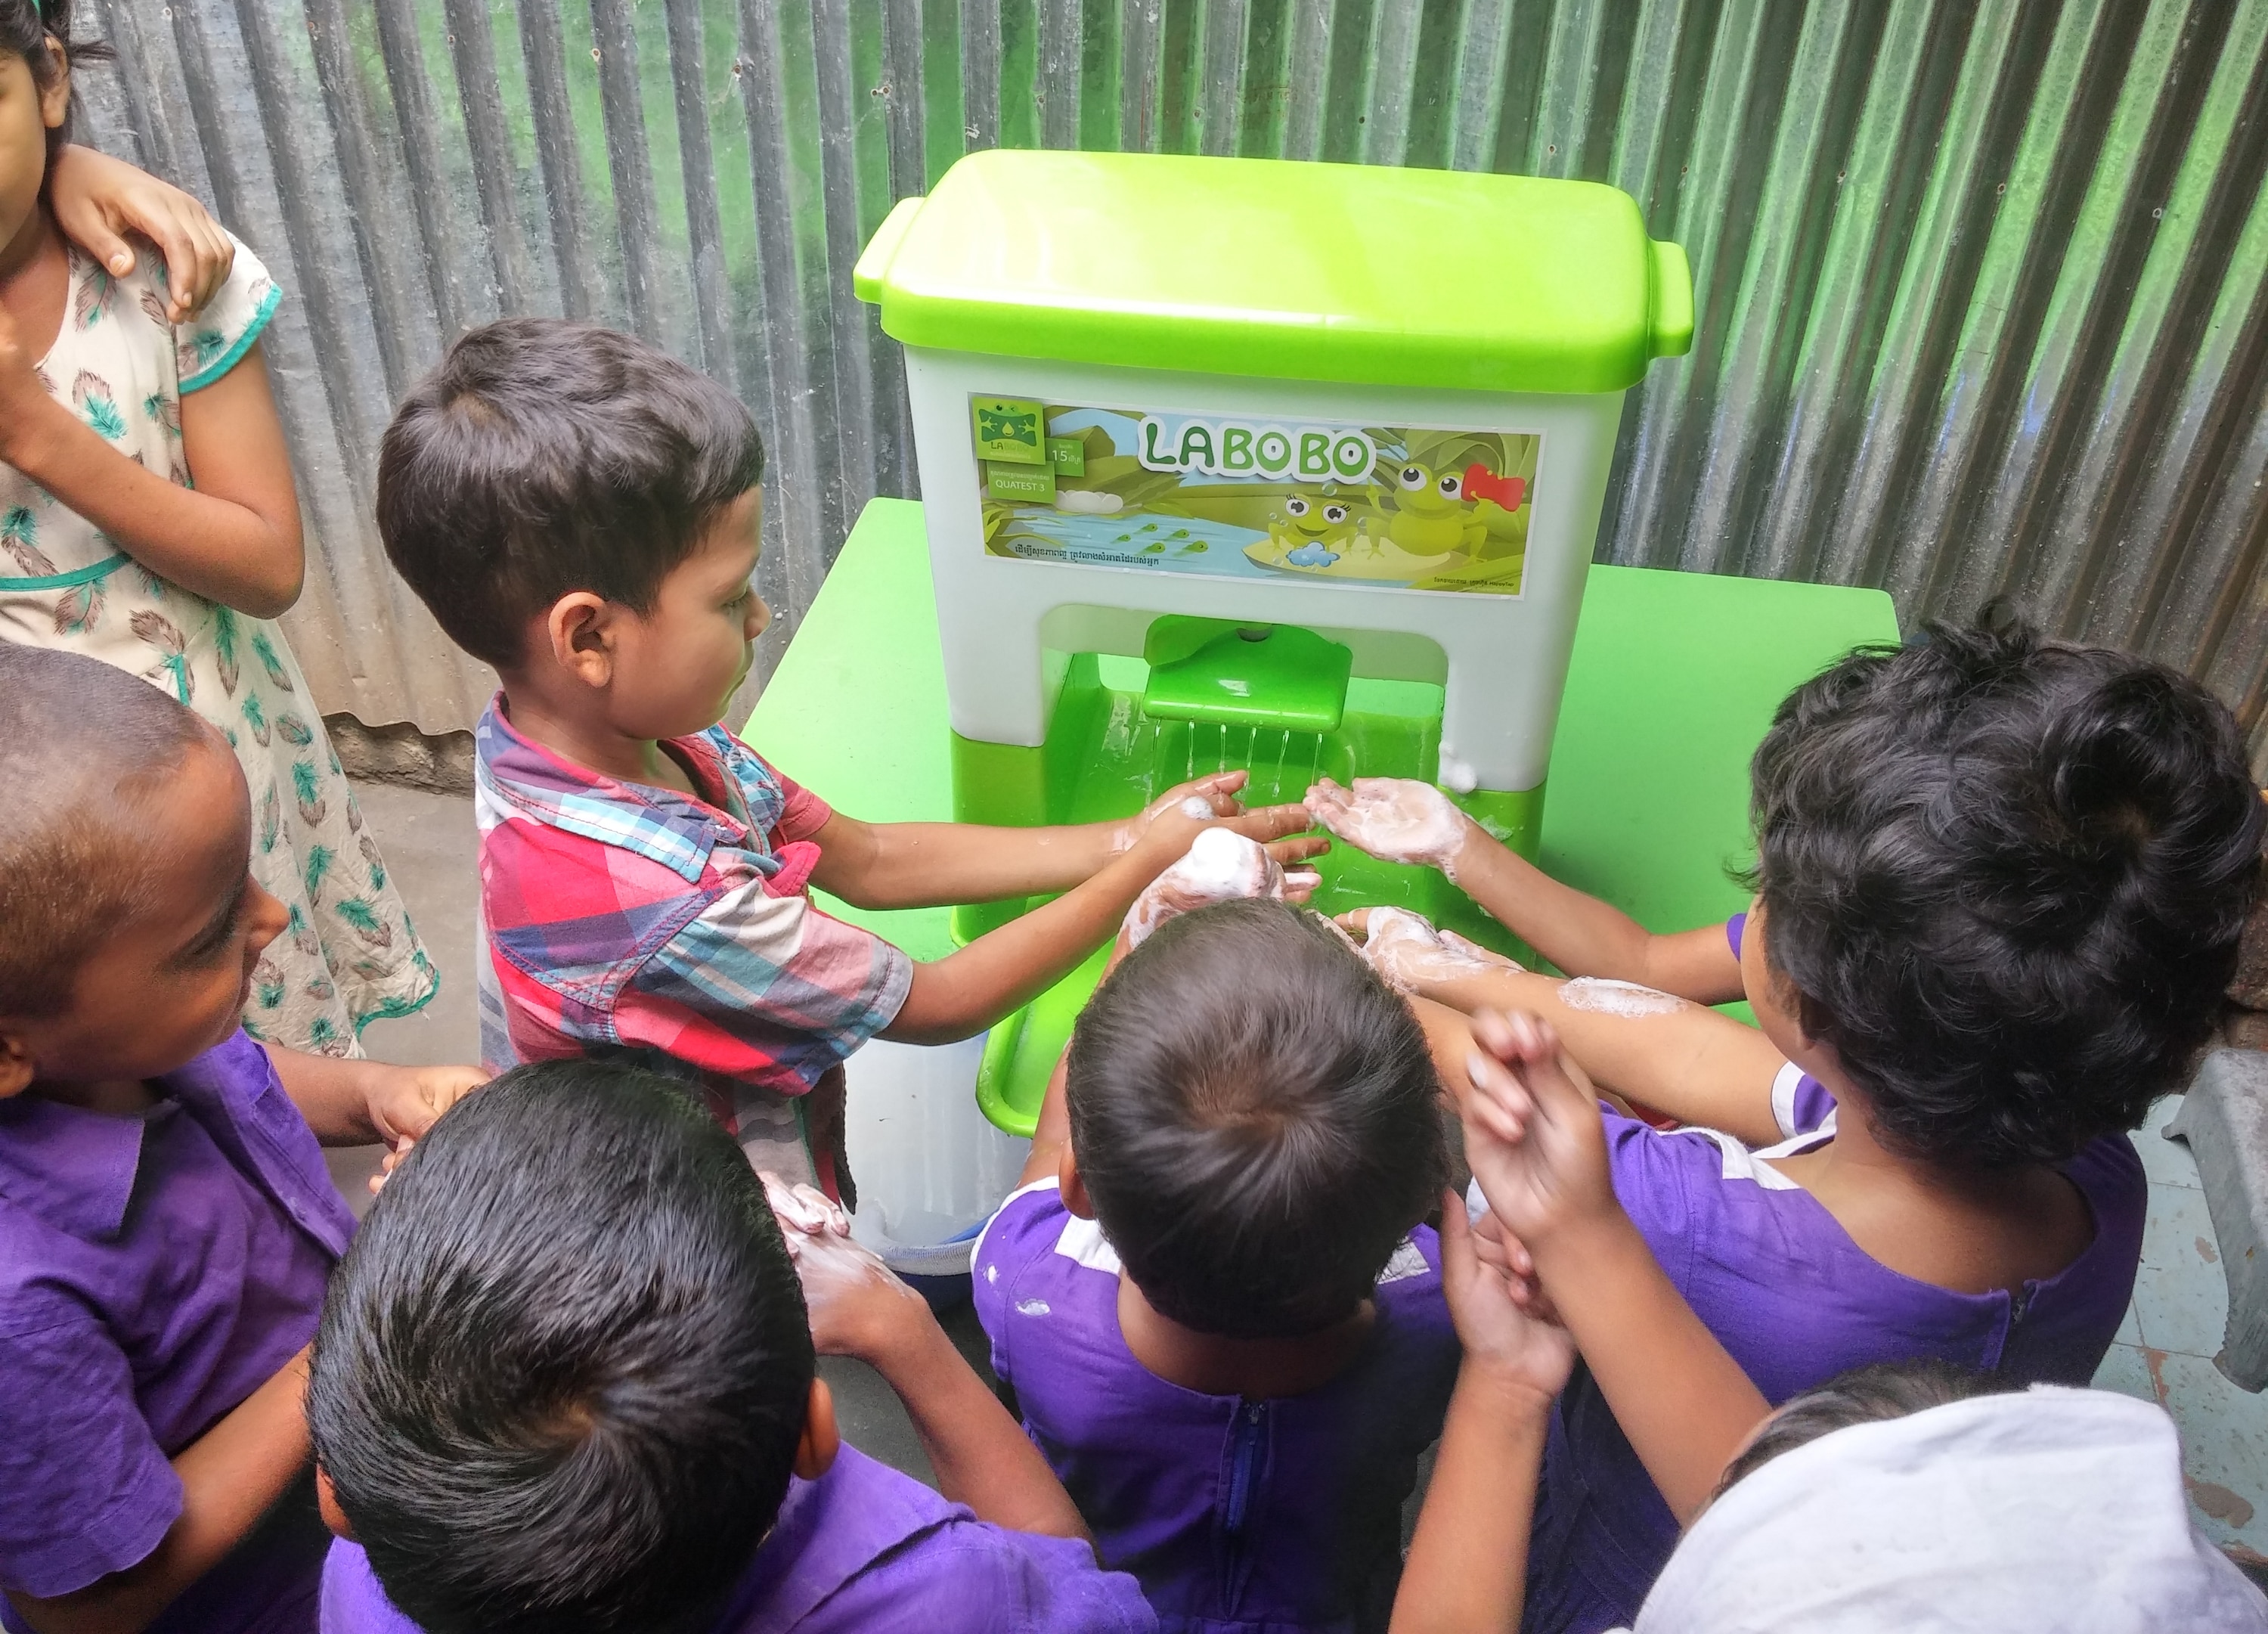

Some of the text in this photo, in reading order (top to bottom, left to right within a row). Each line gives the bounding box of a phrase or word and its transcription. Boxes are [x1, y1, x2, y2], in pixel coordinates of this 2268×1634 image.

[1145, 423, 1370, 477] LABOBO
[996, 479, 1046, 492] QUATEST 3
